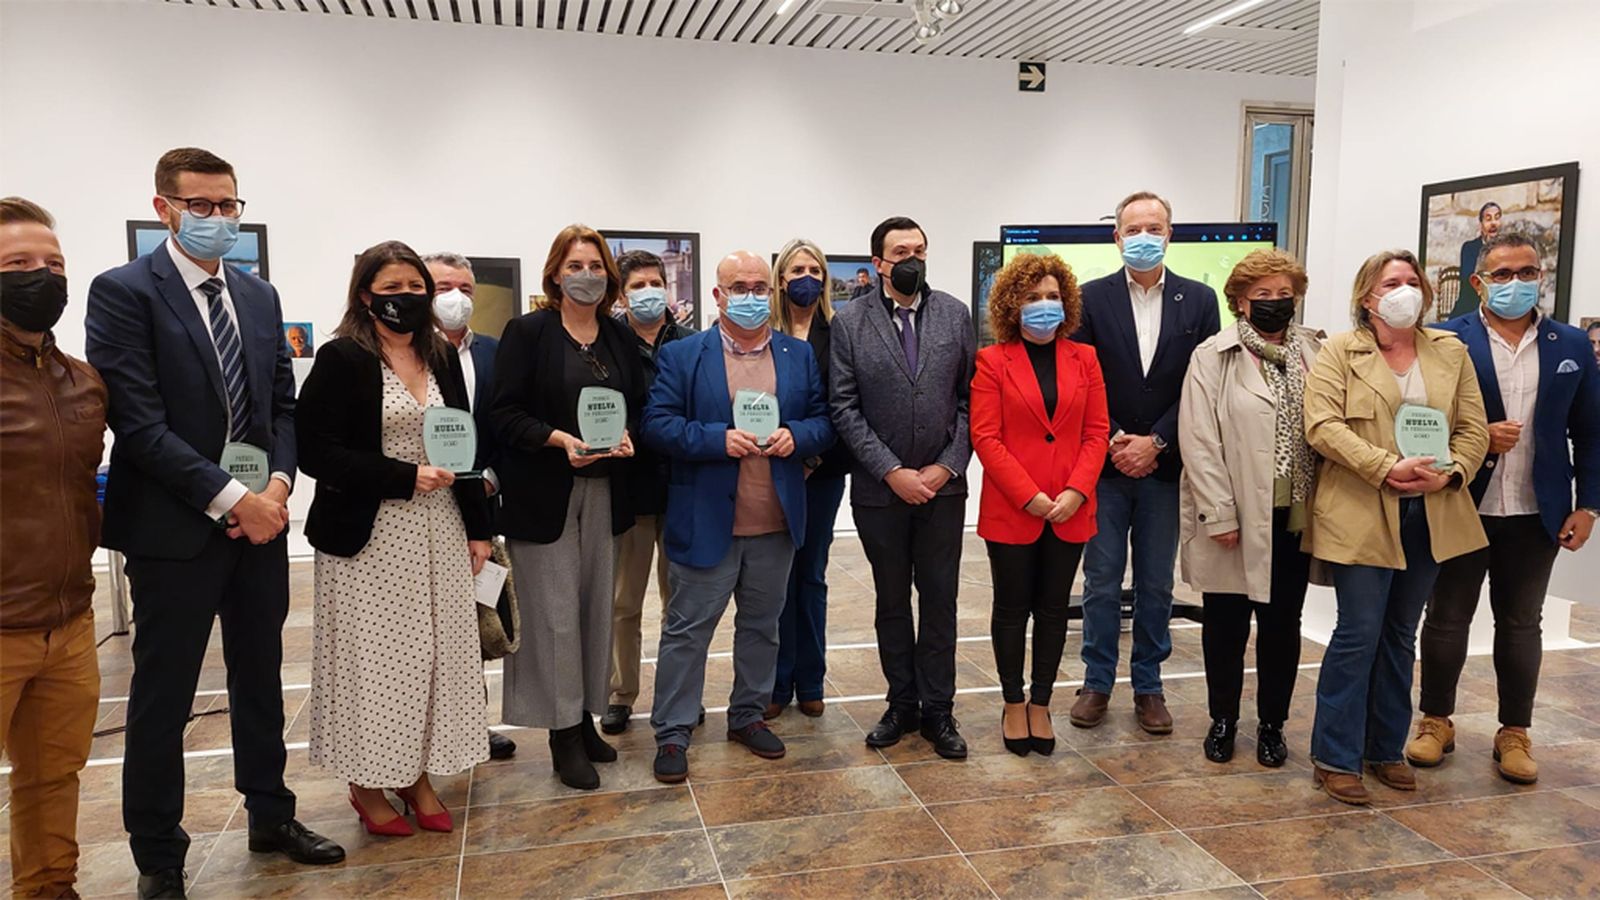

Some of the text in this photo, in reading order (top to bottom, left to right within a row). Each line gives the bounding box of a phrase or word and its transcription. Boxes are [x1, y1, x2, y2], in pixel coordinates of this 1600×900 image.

[587, 402, 616, 410] HUELVA
[434, 424, 466, 432] HUELVA
[229, 464, 258, 472] HUELVA
